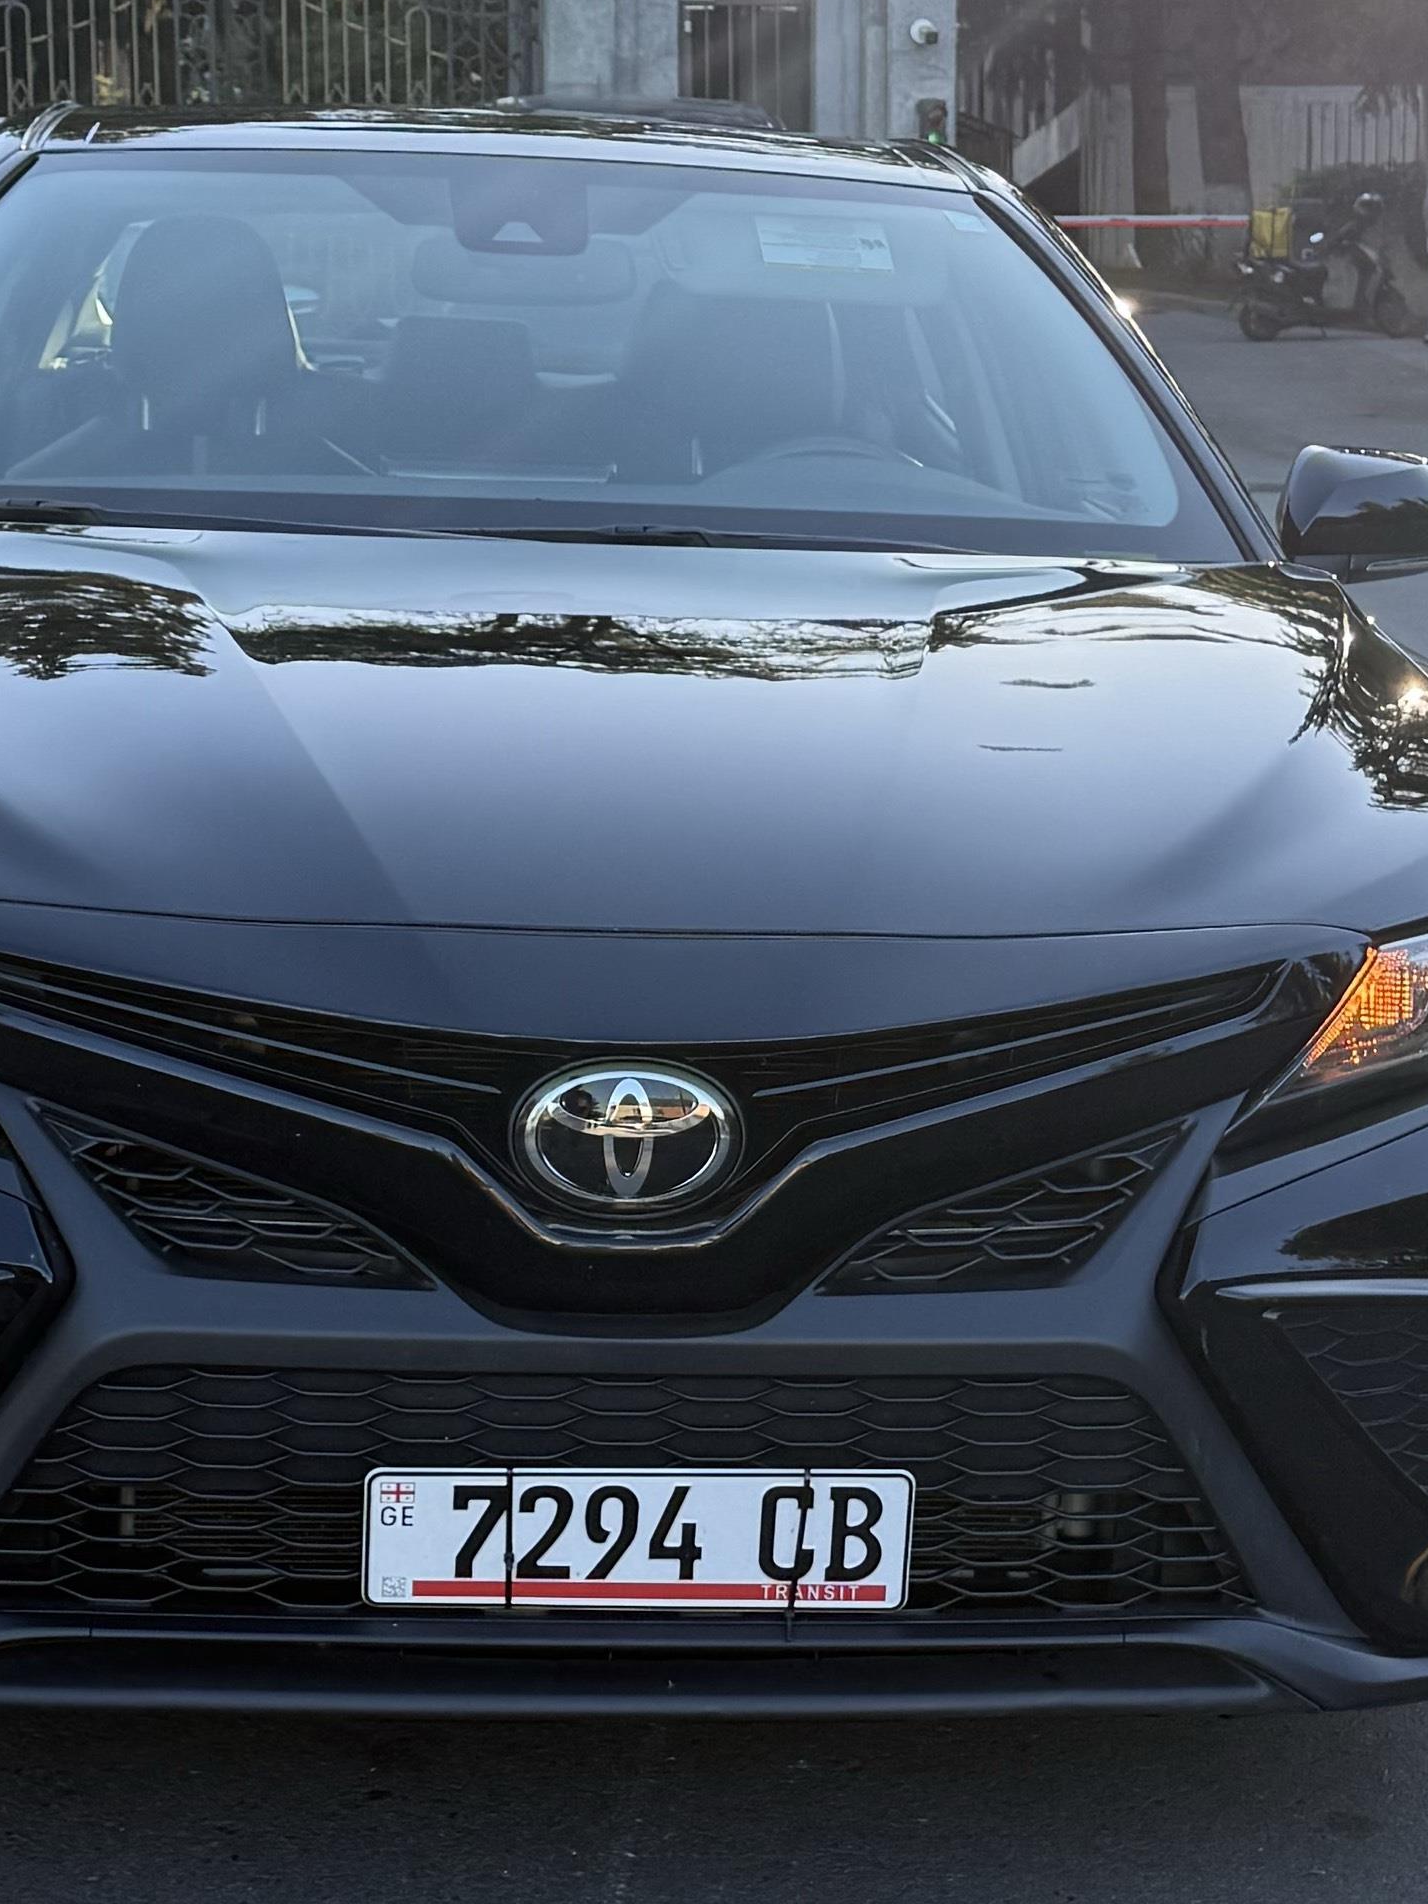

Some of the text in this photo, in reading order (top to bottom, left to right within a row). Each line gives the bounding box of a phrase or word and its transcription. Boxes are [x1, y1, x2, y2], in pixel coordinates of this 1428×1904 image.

[380, 1506, 414, 1526] GE
[453, 1485, 884, 1582] 7294 CB
[762, 1584, 859, 1601] TRANSIT
